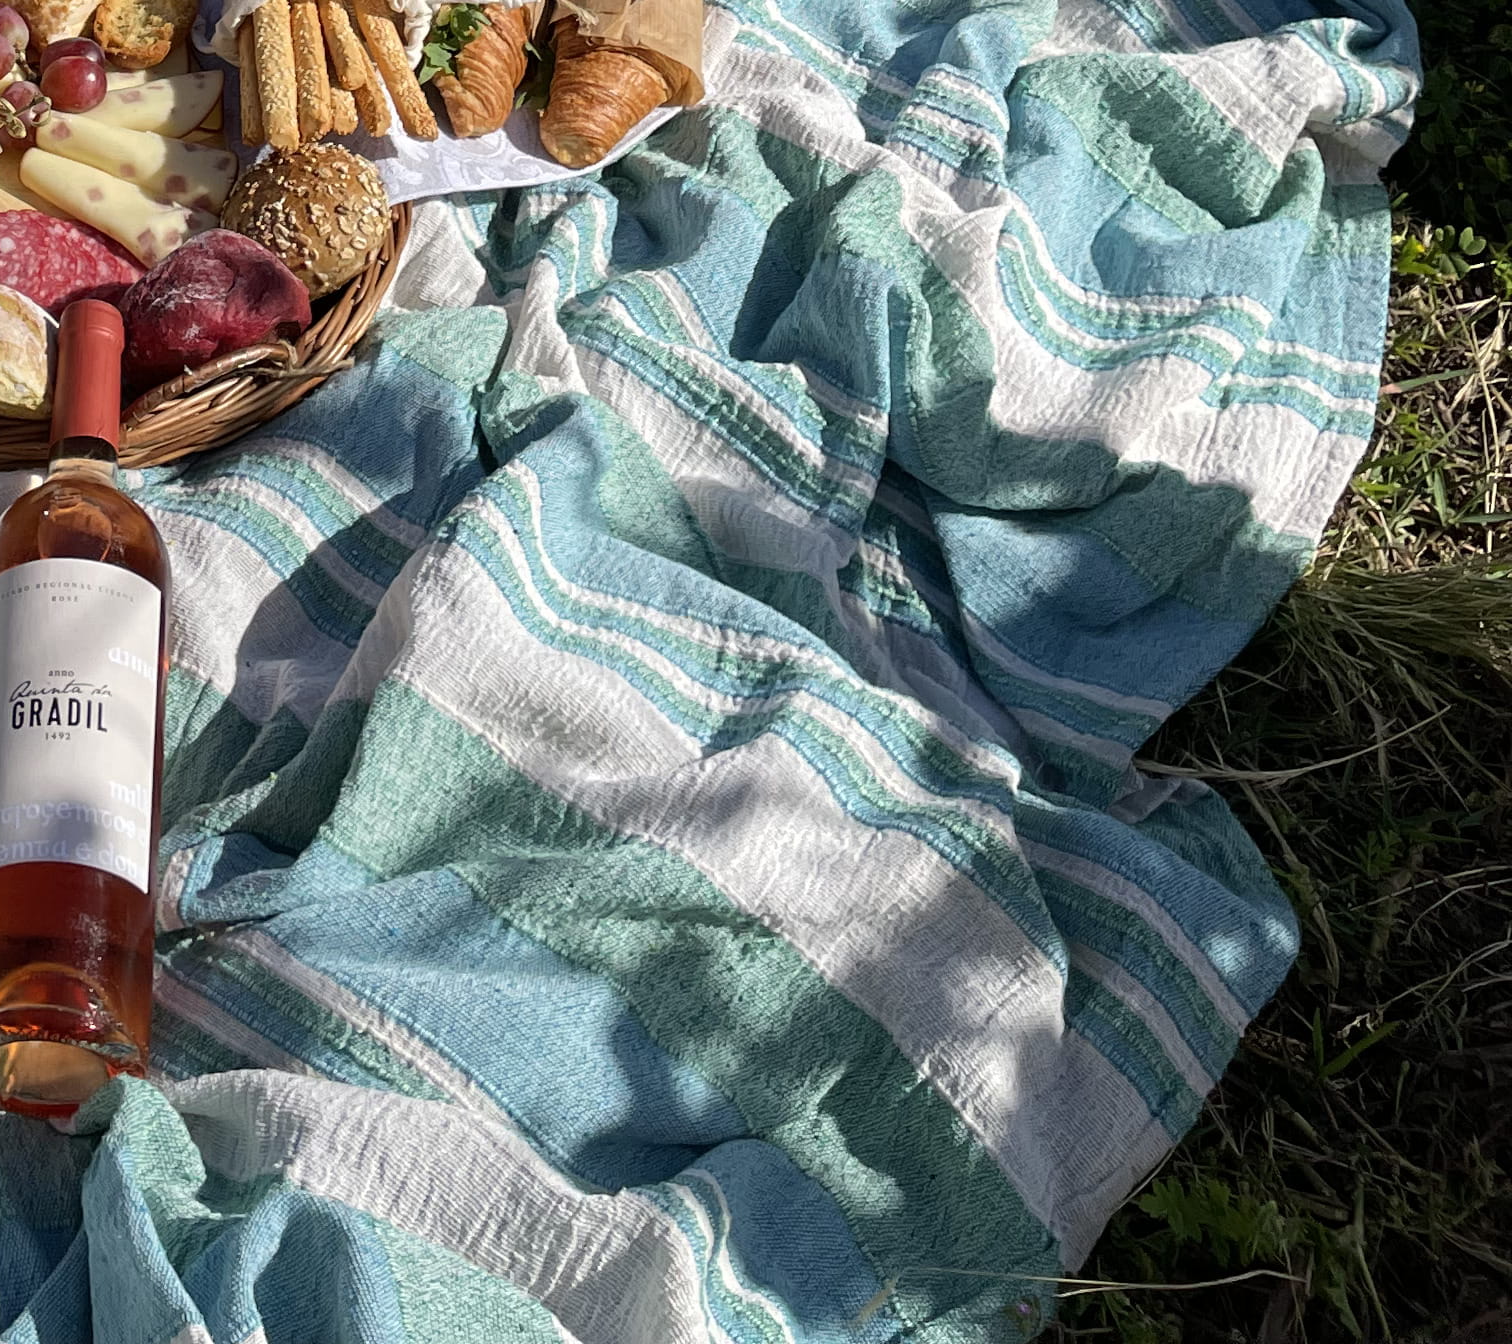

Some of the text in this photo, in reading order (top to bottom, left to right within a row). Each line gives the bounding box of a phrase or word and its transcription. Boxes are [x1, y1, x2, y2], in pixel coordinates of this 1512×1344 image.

[48, 669, 75, 677] anno
[11, 697, 108, 733] GRADIL
[45, 732, 71, 741] 1492
